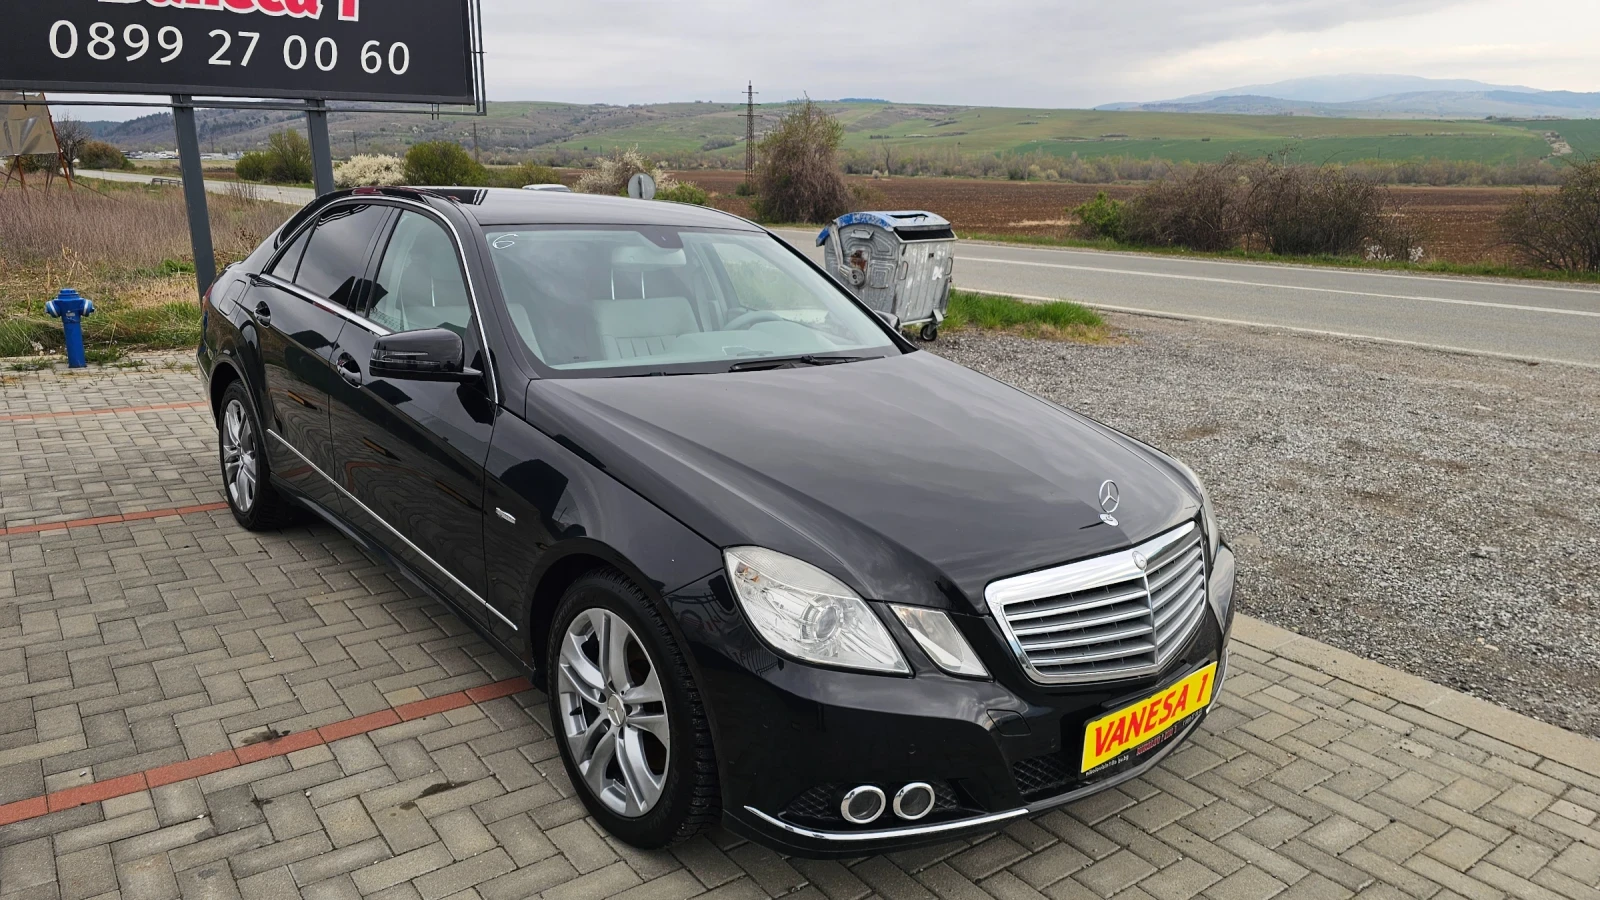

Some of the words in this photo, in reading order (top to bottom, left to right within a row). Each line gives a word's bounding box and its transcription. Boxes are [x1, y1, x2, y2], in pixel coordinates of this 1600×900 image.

[48, 19, 184, 64] 0899
[208, 28, 260, 67] 27
[283, 34, 338, 72] 00
[360, 39, 410, 76] 60
[492, 233, 519, 250] 6
[1094, 683, 1190, 758] VANESA
